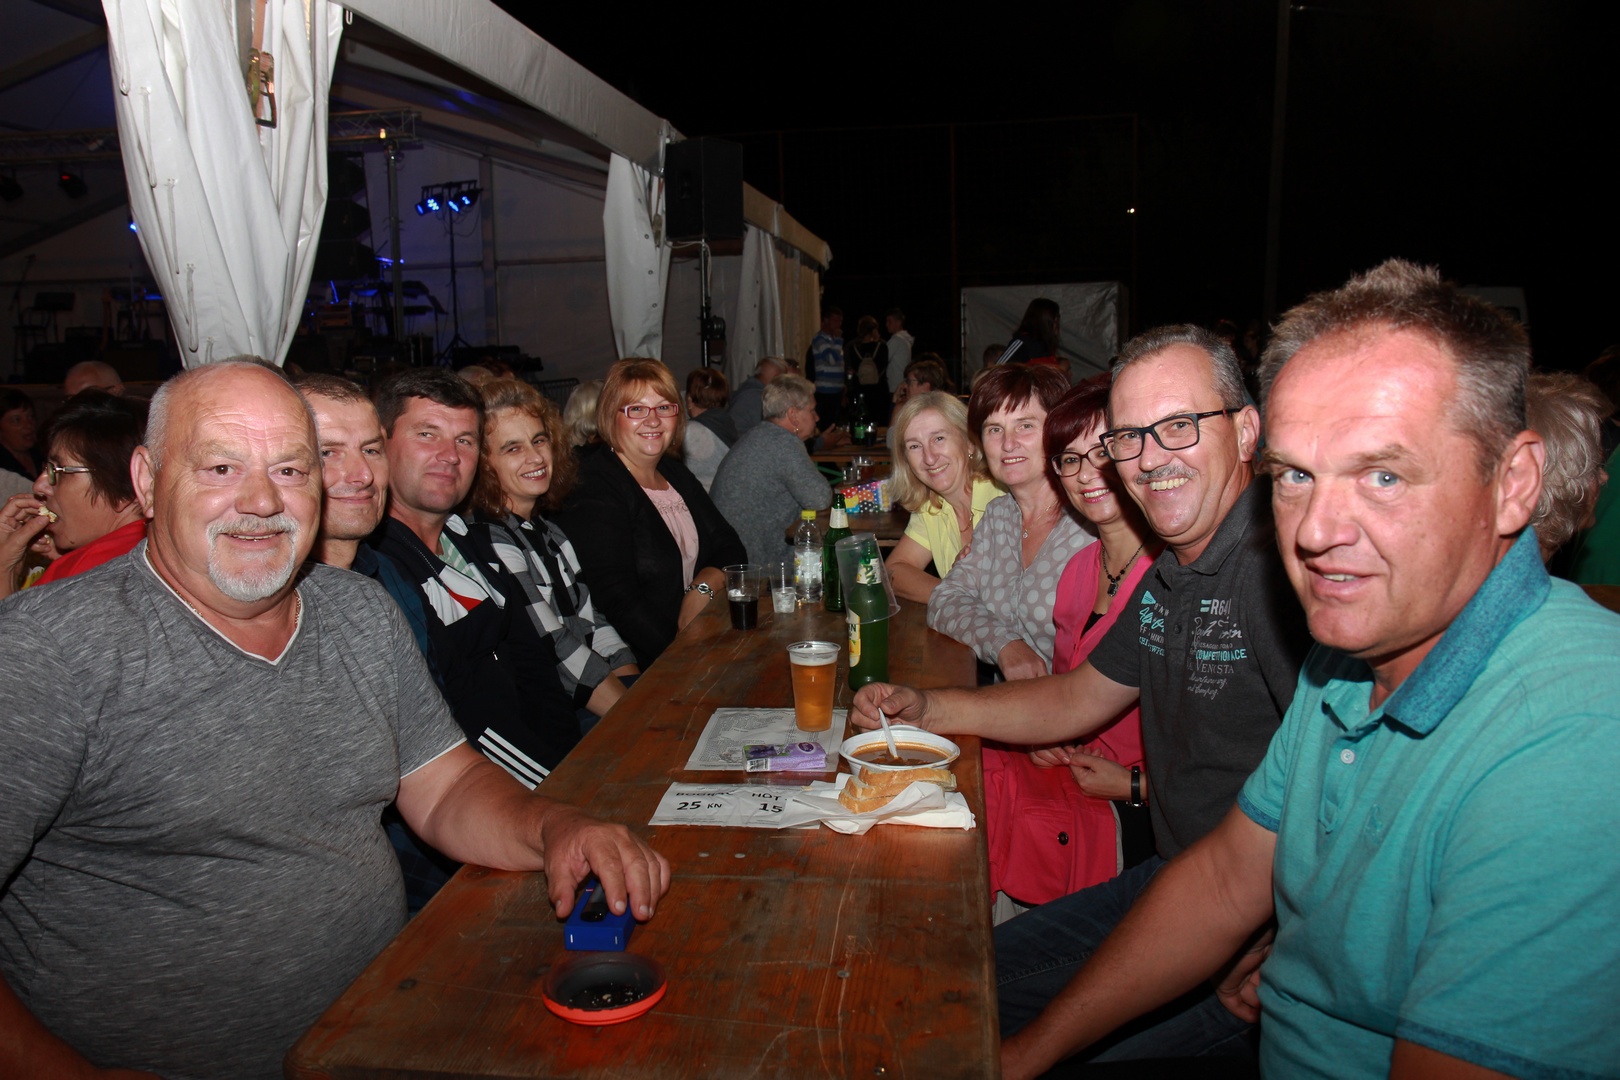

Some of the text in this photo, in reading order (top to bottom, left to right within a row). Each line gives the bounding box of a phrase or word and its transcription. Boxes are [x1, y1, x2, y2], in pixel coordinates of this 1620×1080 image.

[751, 793, 782, 801] HOT
[676, 800, 702, 811] 25
[758, 803, 783, 813] 15
